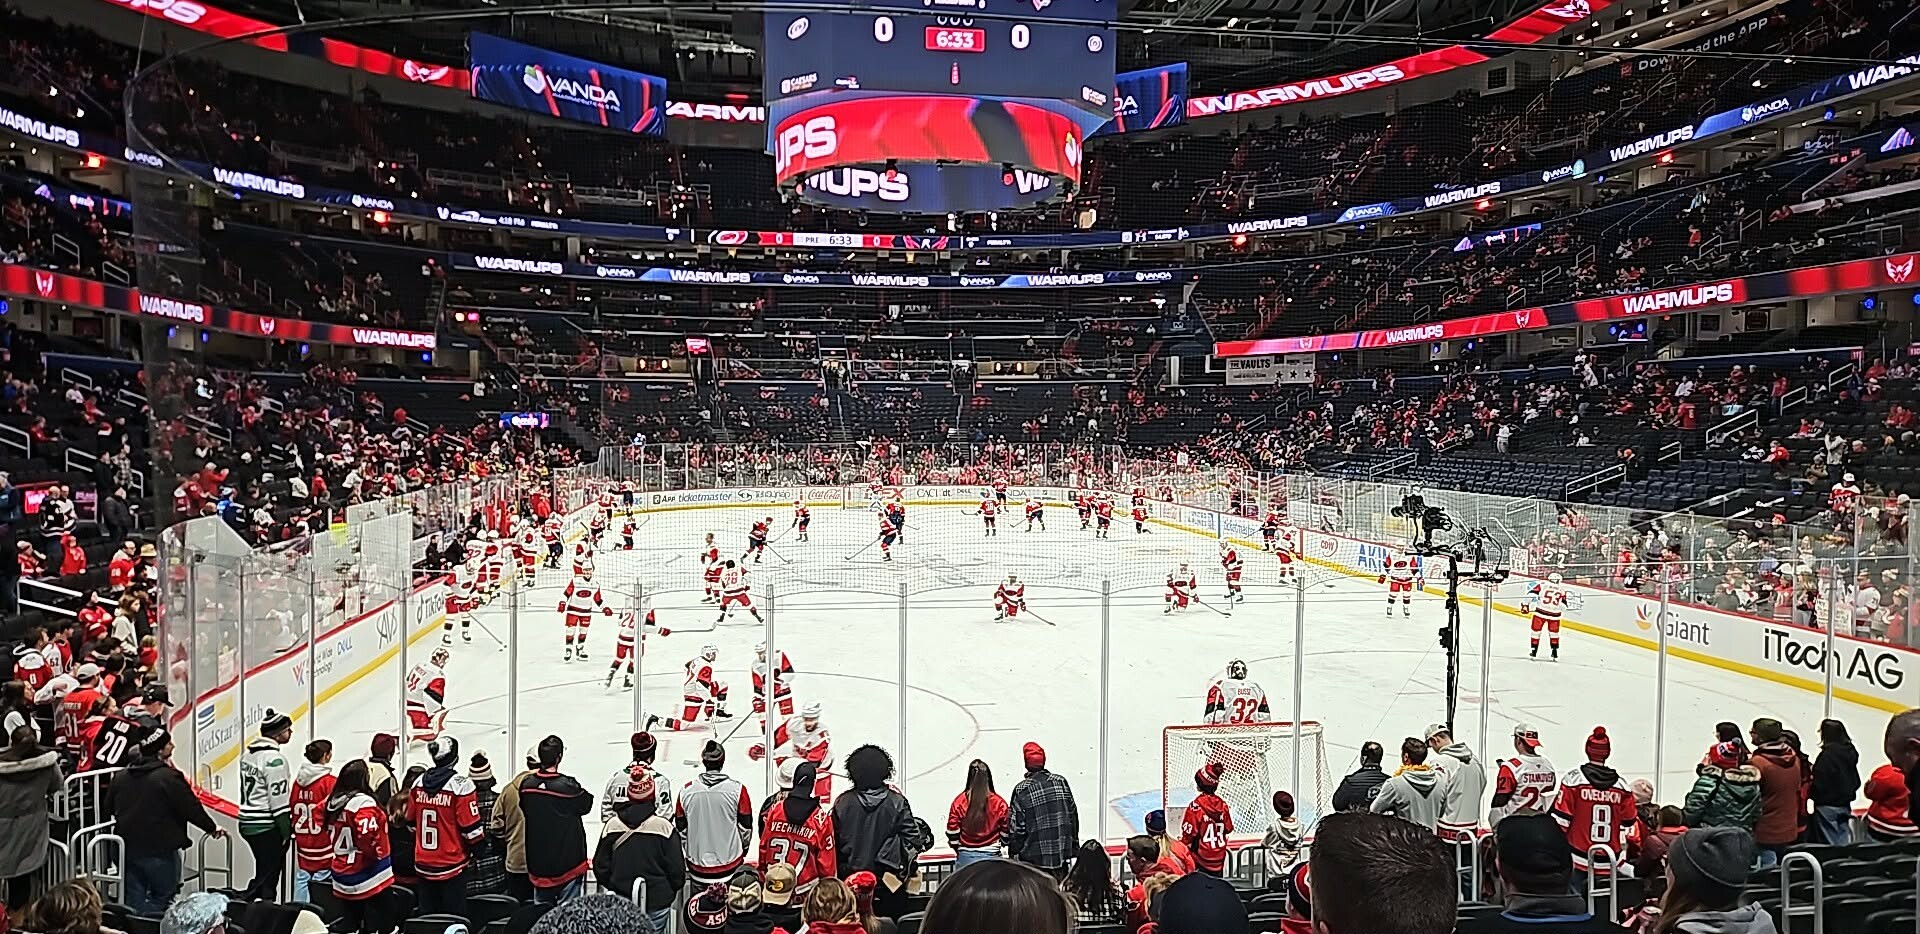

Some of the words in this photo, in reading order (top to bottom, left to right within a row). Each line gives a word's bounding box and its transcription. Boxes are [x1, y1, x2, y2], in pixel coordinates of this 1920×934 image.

[874, 16, 894, 42] 0
[1011, 24, 1030, 49] 0
[935, 31, 975, 48] 6:33
[1638, 37, 1711, 71] Dowad
[1713, 32, 1736, 47] the
[1738, 17, 1768, 38] APP
[546, 74, 620, 107] VANDA
[1193, 64, 1405, 114] WARMUPS
[666, 101, 764, 121] ARM
[1751, 97, 1789, 117] VANDA
[0, 107, 80, 147] WARMUPS
[1610, 125, 1693, 162] WARMUPS
[133, 152, 164, 168] VANDA
[1549, 165, 1573, 179] VANDA
[213, 167, 305, 199] WARMUPS
[1425, 181, 1500, 208] WARMUPS
[361, 197, 394, 211] VANDA
[1353, 206, 1383, 218] VANDA
[1228, 216, 1307, 234] WARMUPS
[776, 233, 783, 244] 0
[805, 236, 819, 244] PRE
[829, 235, 852, 245] 6:33
[873, 235, 880, 246] 0
[475, 255, 563, 275] WARMUPS
[605, 267, 636, 278] VANDA
[670, 269, 750, 284] WARMUPS
[791, 275, 819, 284] VANDA
[852, 275, 929, 287] WARMUPS
[967, 277, 996, 286] VANDA
[1027, 273, 1104, 286] WARMUPS
[1144, 272, 1172, 281] VANDA
[1623, 283, 1733, 314] WARMUPS
[139, 295, 204, 323] WARMUPS
[353, 328, 435, 348] WARMUPS
[1386, 325, 1444, 344] WARMUPS
[1241, 359, 1270, 369] VAULTS
[678, 491, 732, 502] ticketmaster
[917, 488, 938, 497] CACI
[1320, 540, 1335, 550] CDW
[1358, 544, 1388, 573] AKI
[1543, 590, 1562, 606] 53
[1656, 611, 1710, 646] Giant
[337, 637, 353, 655] DELL
[1764, 628, 1841, 677] iTech
[1846, 648, 1904, 690] AG
[306, 661, 333, 678] Tchnology
[234, 704, 263, 736] Halth
[1230, 698, 1258, 724] 32
[96, 731, 127, 765] 20
[270, 780, 287, 796] 37
[298, 790, 314, 801] AHO
[469, 801, 479, 817] 6
[294, 802, 322, 835] 20
[358, 816, 379, 834] 74
[1590, 804, 1611, 842] 8
[421, 808, 438, 850] 6
[1182, 822, 1193, 835] 43
[1202, 822, 1226, 850] 43
[770, 837, 809, 877] 37
